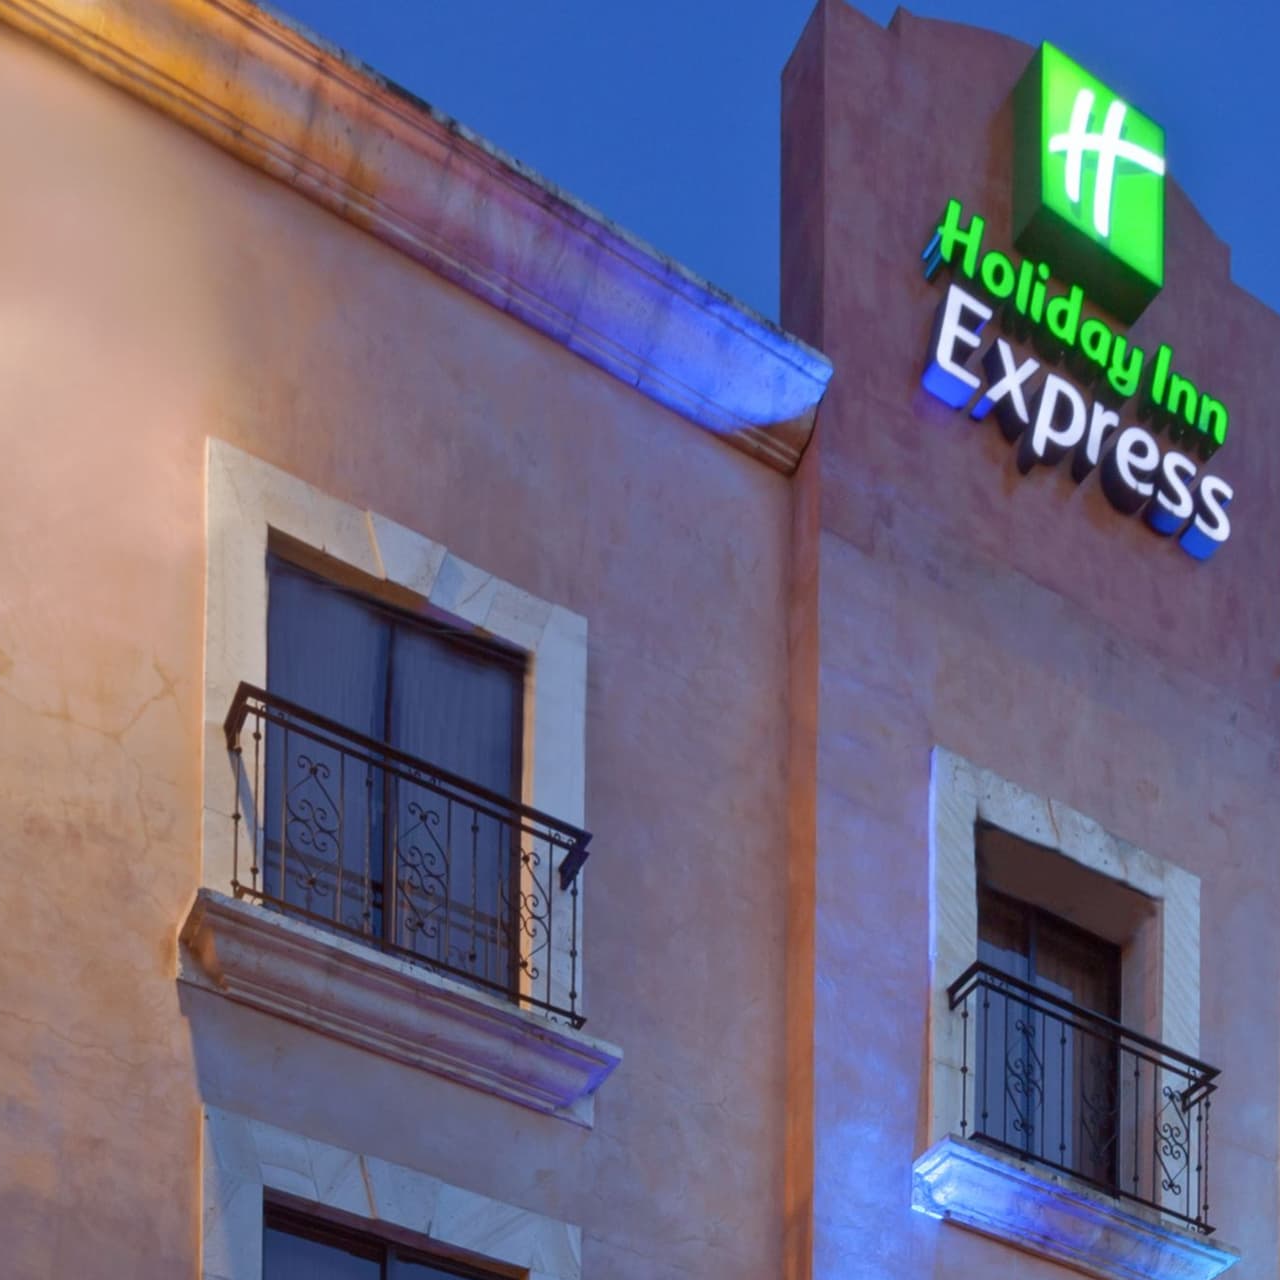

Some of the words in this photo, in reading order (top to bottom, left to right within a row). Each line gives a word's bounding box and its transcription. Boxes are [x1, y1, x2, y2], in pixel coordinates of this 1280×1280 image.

[934, 283, 1234, 542] Express
[937, 199, 1144, 397] Holiday
[1151, 345, 1230, 445] Inn
